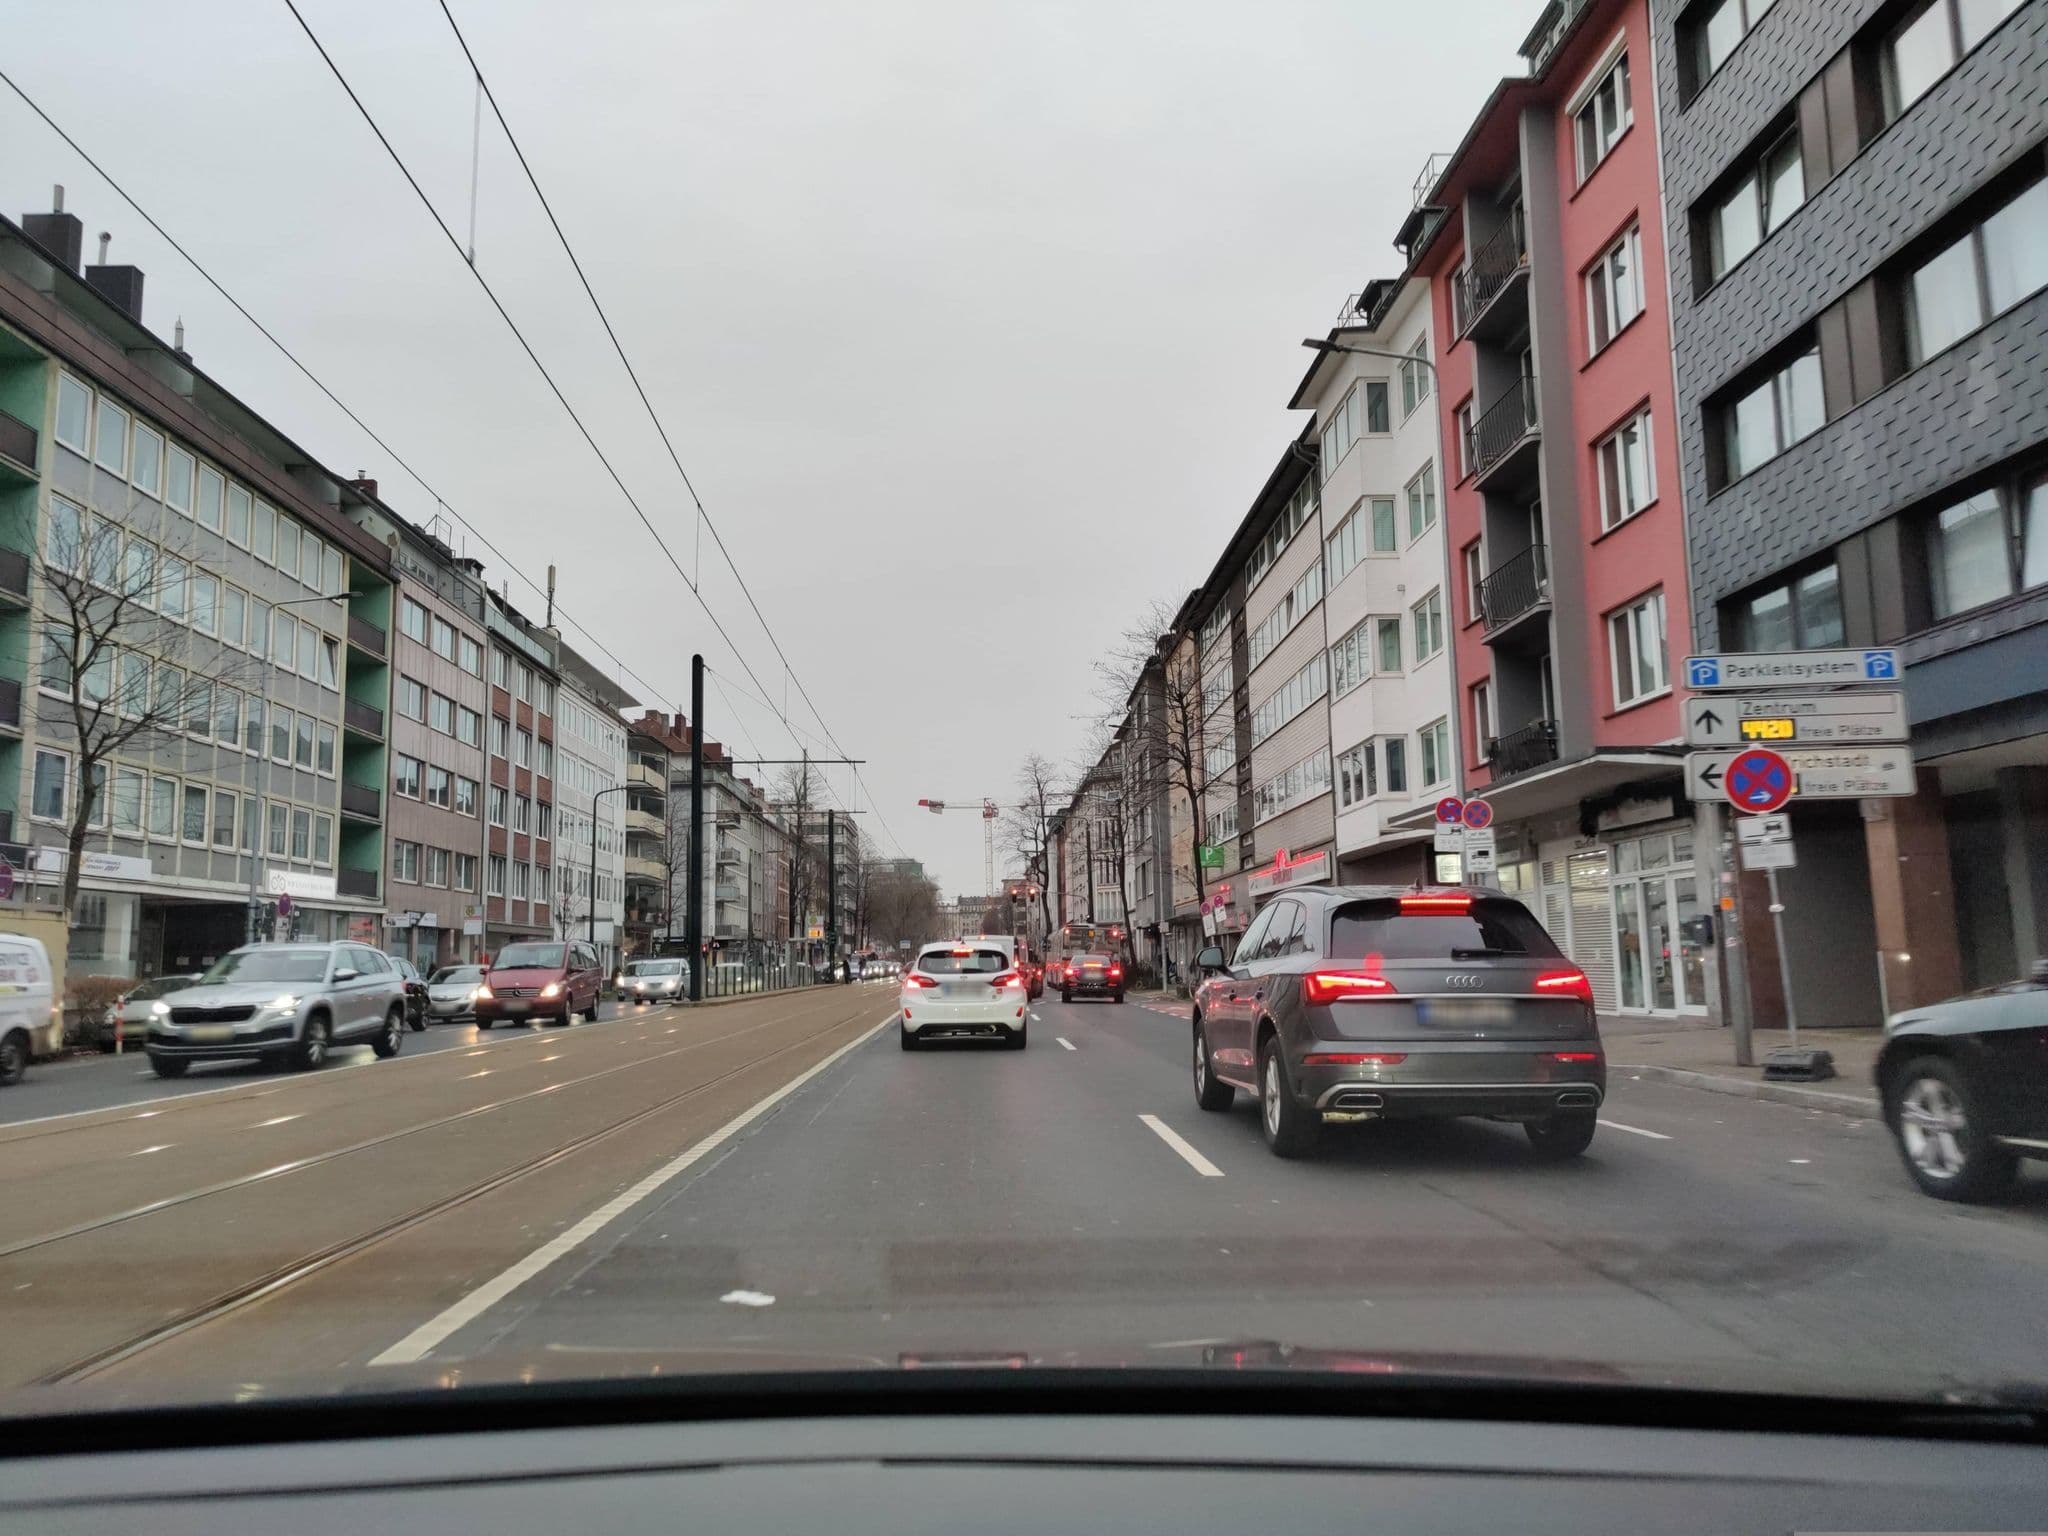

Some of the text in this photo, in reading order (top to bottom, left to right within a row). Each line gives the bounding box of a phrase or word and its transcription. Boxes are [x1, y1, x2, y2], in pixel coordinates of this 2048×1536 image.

[1699, 661, 1889, 683] P Parkleitsystem P
[1742, 701, 1817, 716] Zentrum
